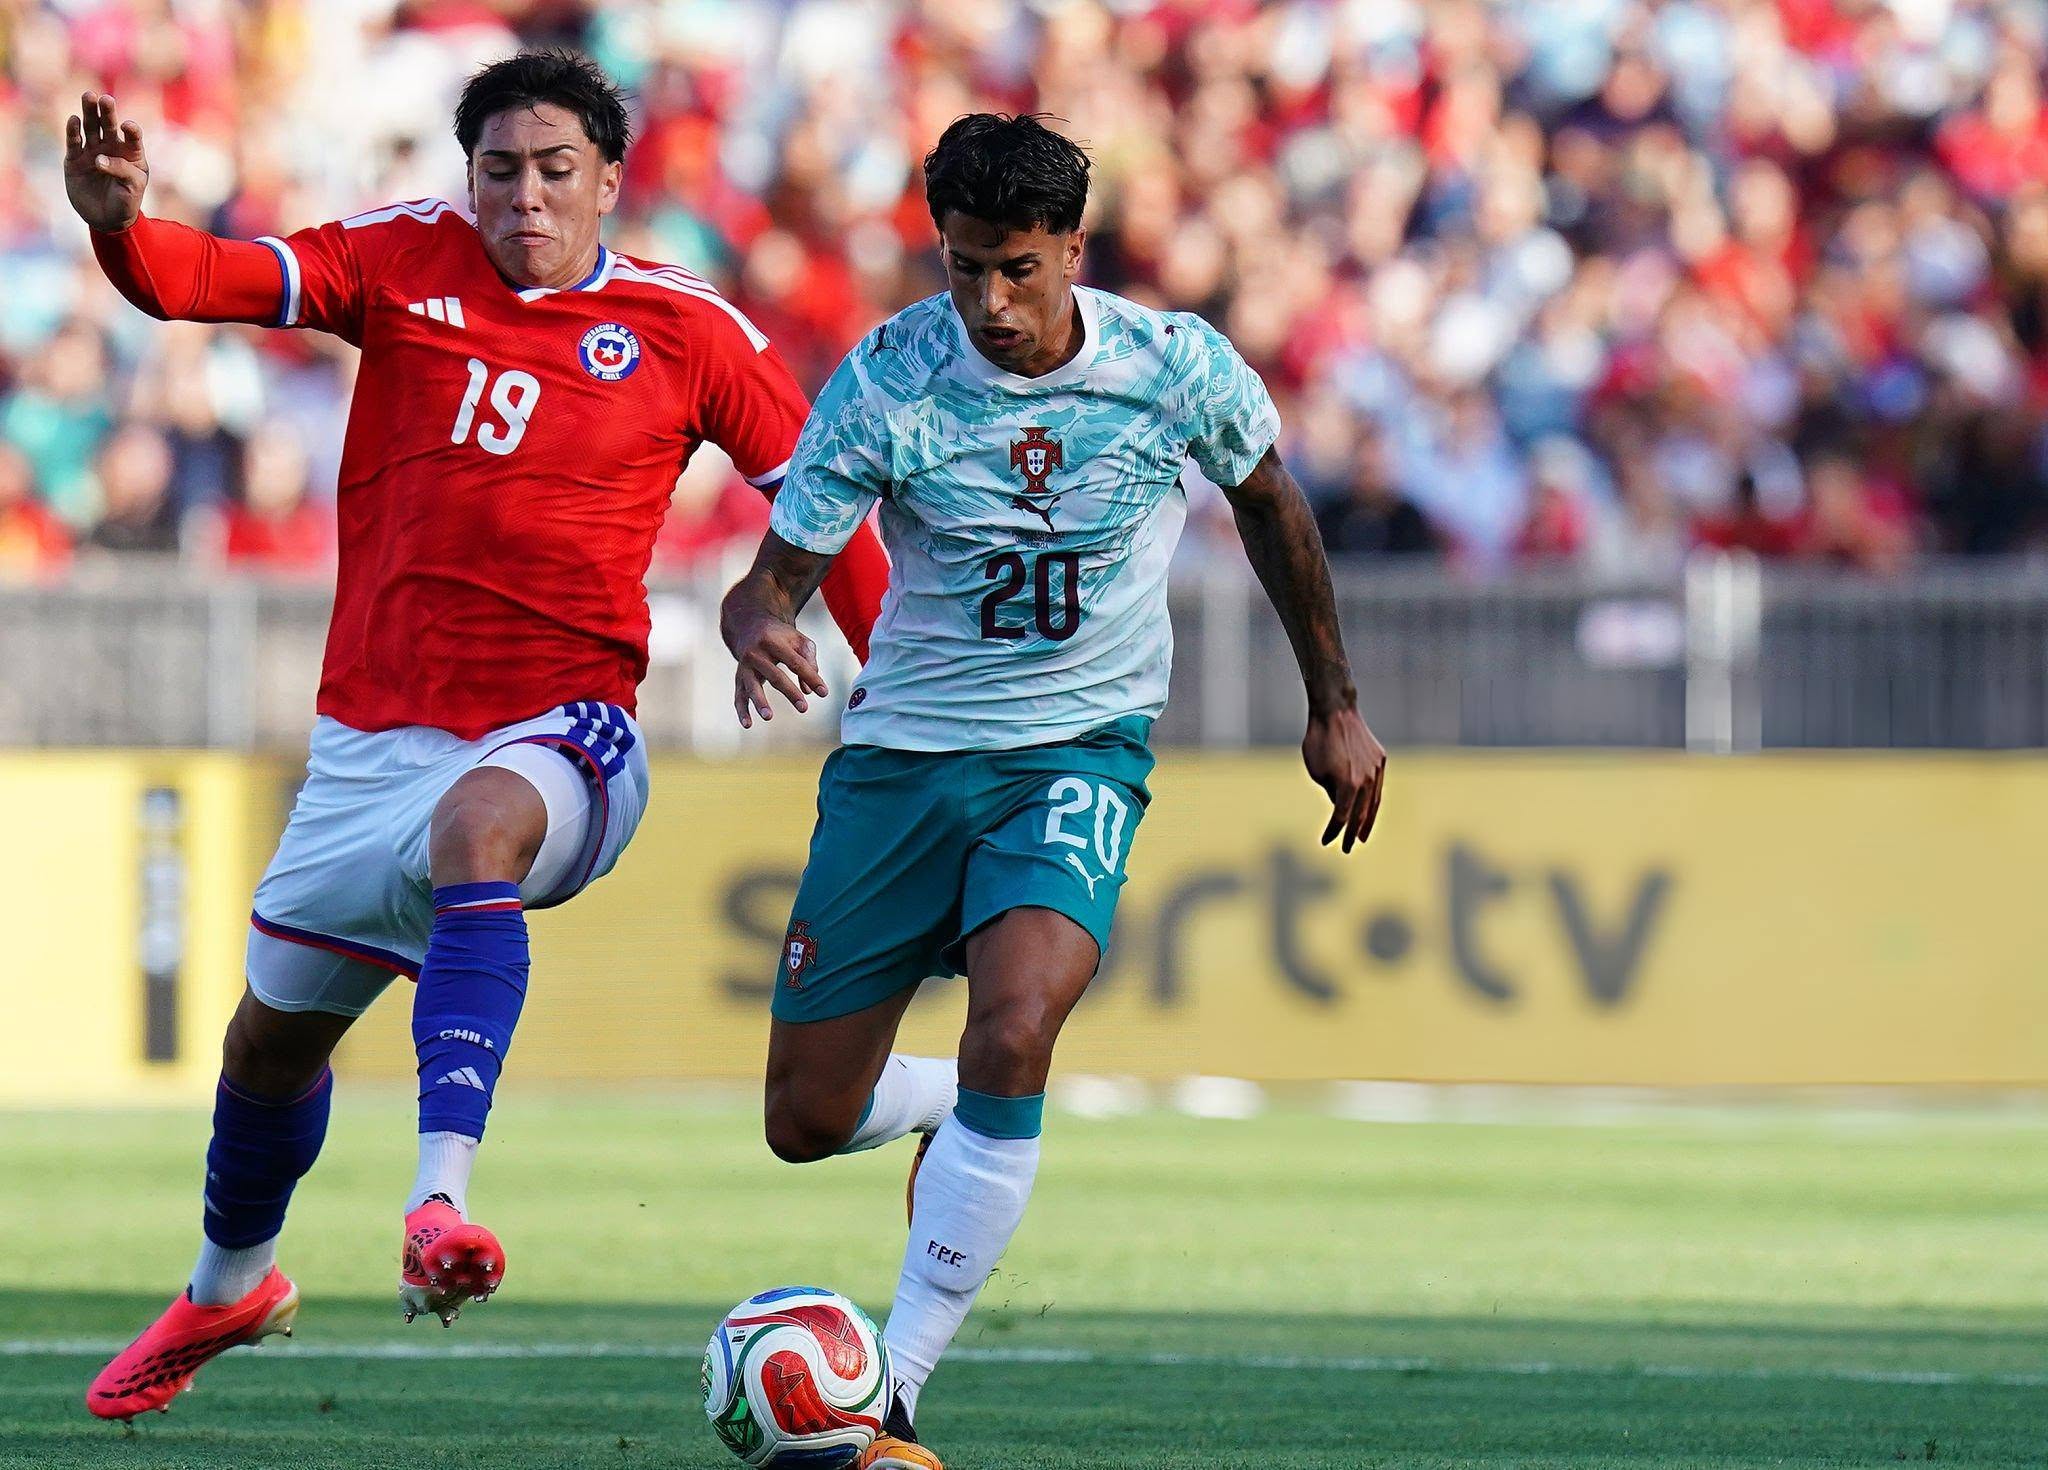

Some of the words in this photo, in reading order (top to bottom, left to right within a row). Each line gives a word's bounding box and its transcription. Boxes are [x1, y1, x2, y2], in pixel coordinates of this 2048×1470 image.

[451, 357, 541, 456] 19
[980, 550, 1081, 642] 20
[1043, 776, 1129, 875] 20
